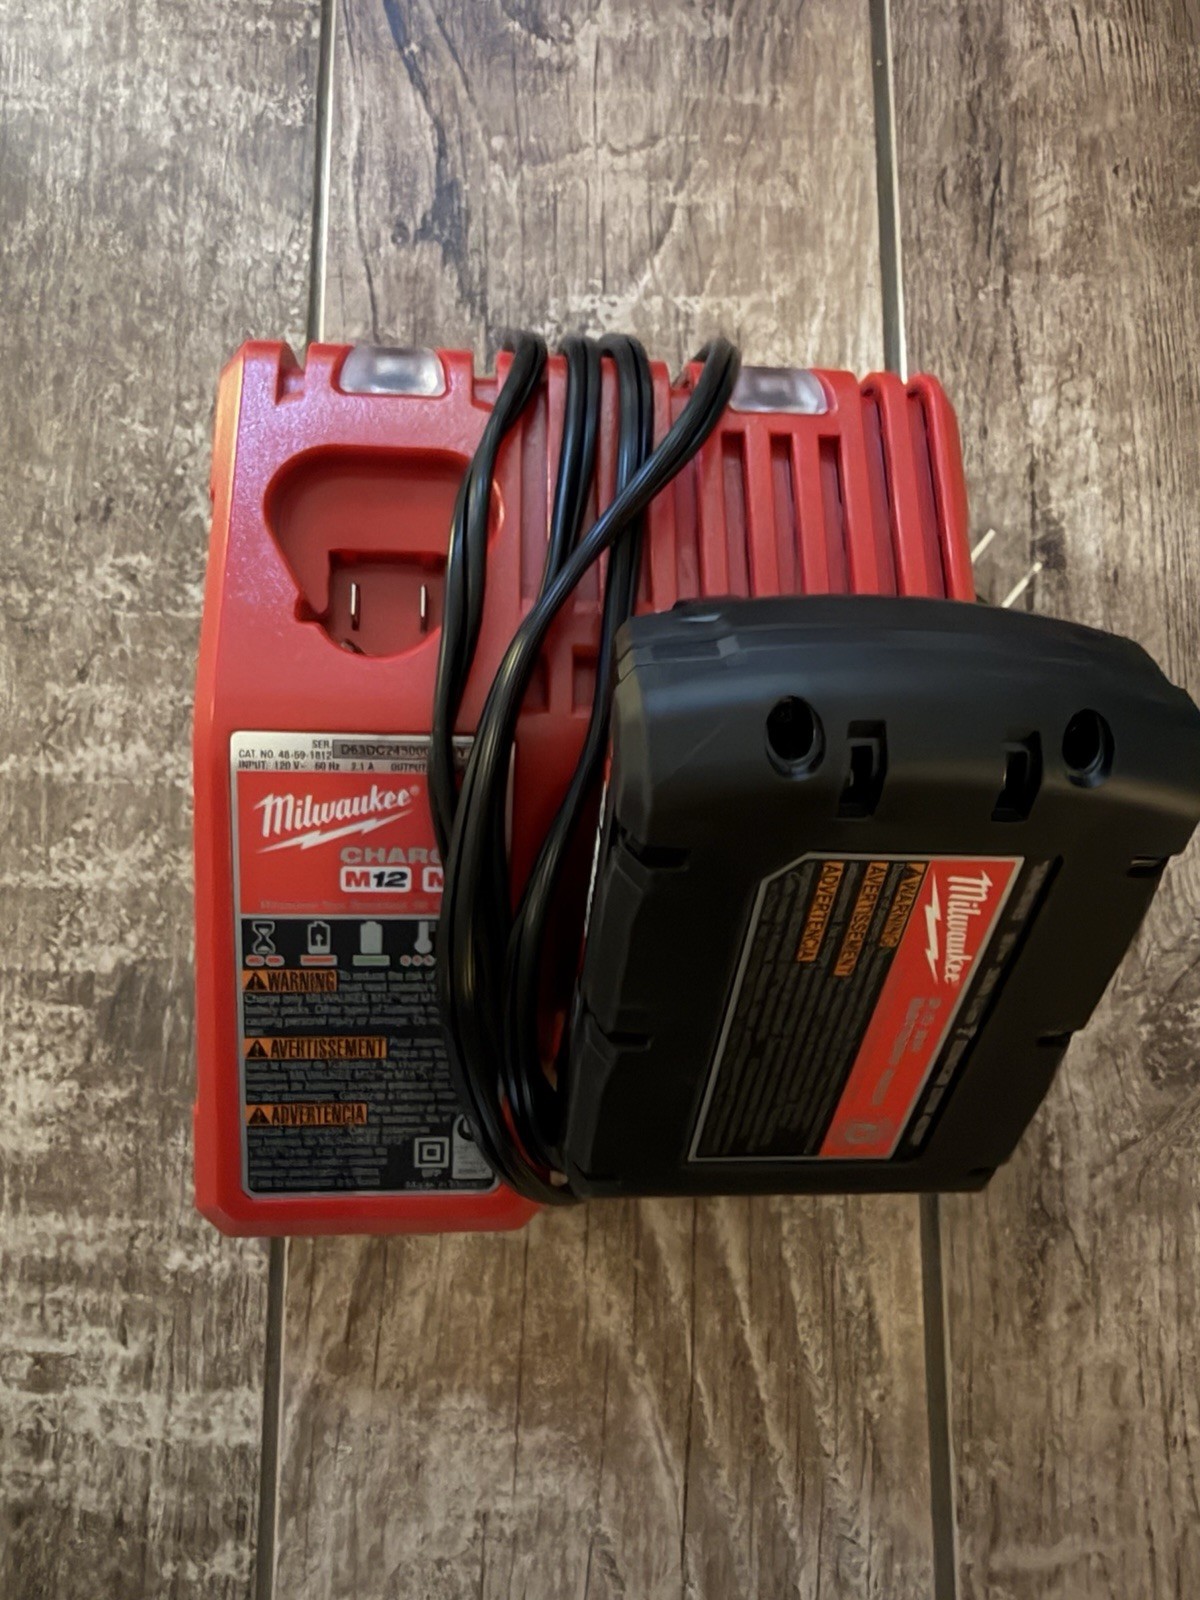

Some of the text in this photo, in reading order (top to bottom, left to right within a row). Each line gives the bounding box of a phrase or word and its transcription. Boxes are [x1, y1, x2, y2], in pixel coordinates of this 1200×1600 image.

[274, 761, 291, 770] 120
[367, 762, 375, 771] A
[254, 785, 411, 838] Milwaukee
[345, 871, 408, 888] M12
[798, 865, 841, 960] ADVERTENCIA
[882, 875, 921, 947] WARNING
[945, 870, 993, 985] Milwaukee
[268, 971, 335, 991] WARNING
[271, 1038, 385, 1058] AVERTISSEMENT
[272, 1106, 366, 1126] ADVERTENCIA
